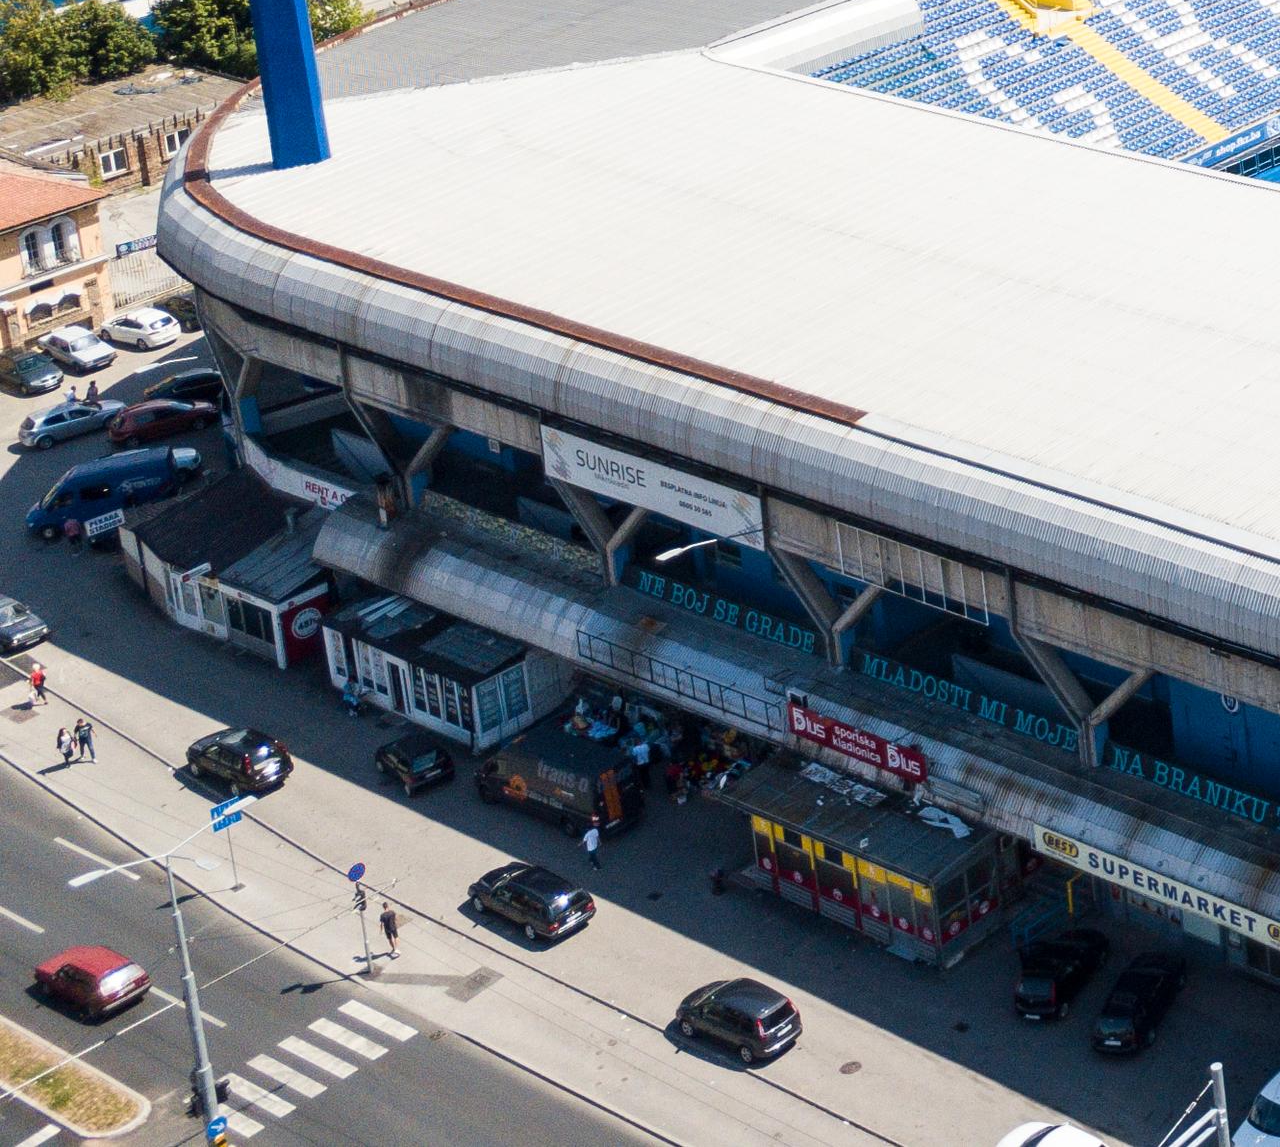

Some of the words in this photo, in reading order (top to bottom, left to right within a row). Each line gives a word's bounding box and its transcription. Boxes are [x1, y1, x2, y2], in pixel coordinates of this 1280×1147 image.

[576, 449, 647, 488] SUNRISE
[305, 481, 330, 498] RENT
[331, 490, 339, 502] A
[89, 511, 120, 528] PEKARA
[89, 517, 123, 535] STADION
[639, 570, 666, 599] NE
[670, 582, 711, 614] BOJ
[713, 598, 740, 626] SE
[745, 607, 816, 654] GRADE
[862, 653, 974, 712] MLADOSTI
[977, 694, 1009, 726] MI
[1013, 708, 1079, 752] MOJE
[831, 734, 882, 764] kladionica
[833, 725, 877, 751] sportska
[1110, 747, 1146, 778] NA
[1153, 760, 1271, 824] BRANIKU
[1046, 834, 1076, 856] BEST
[1088, 852, 1258, 933] SUPERMARKET
